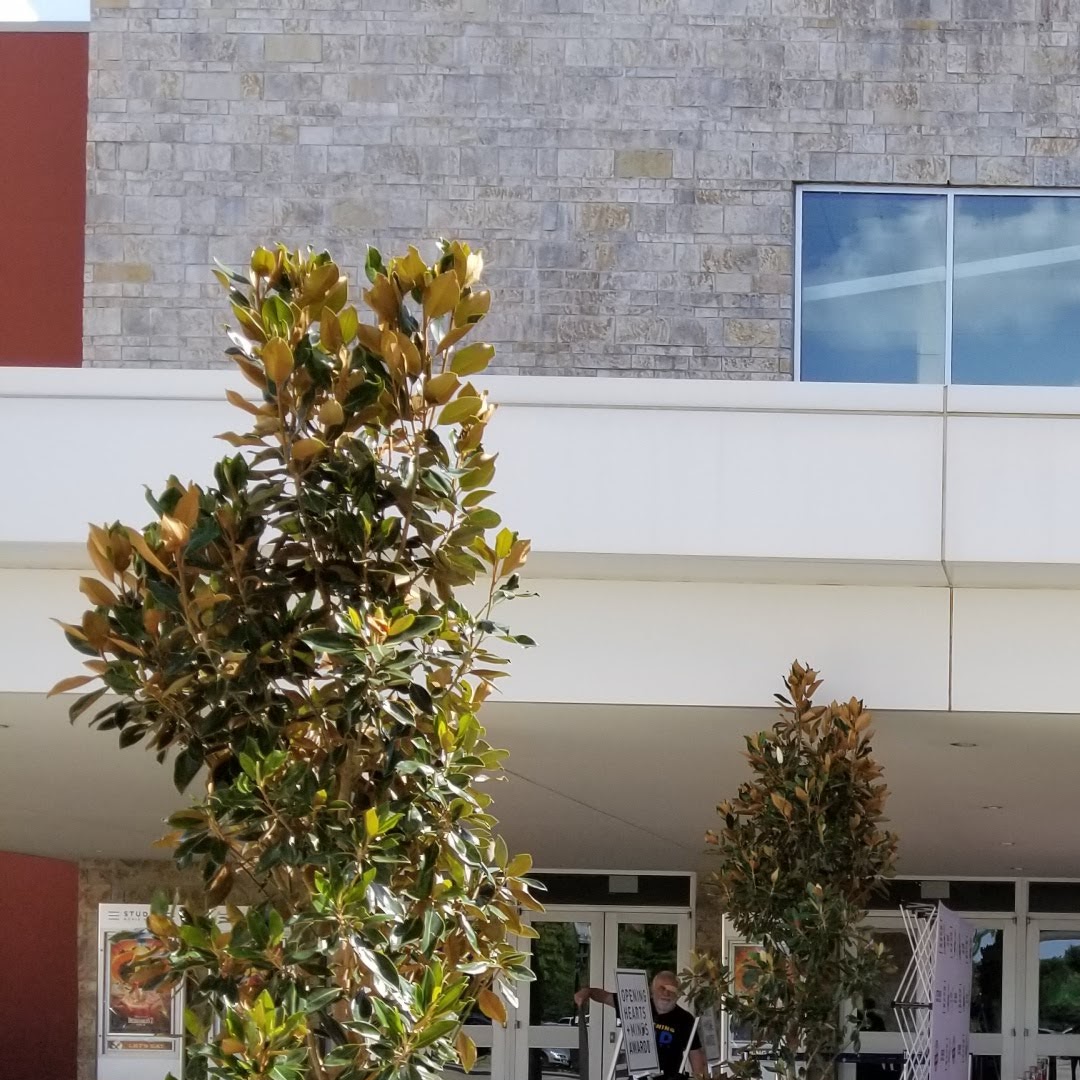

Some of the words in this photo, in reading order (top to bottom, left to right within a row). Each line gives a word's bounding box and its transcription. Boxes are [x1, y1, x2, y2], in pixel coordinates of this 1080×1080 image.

[123, 910, 149, 918] STUD
[621, 989, 647, 1003] OPENING
[624, 1006, 647, 1020] HEARTS
